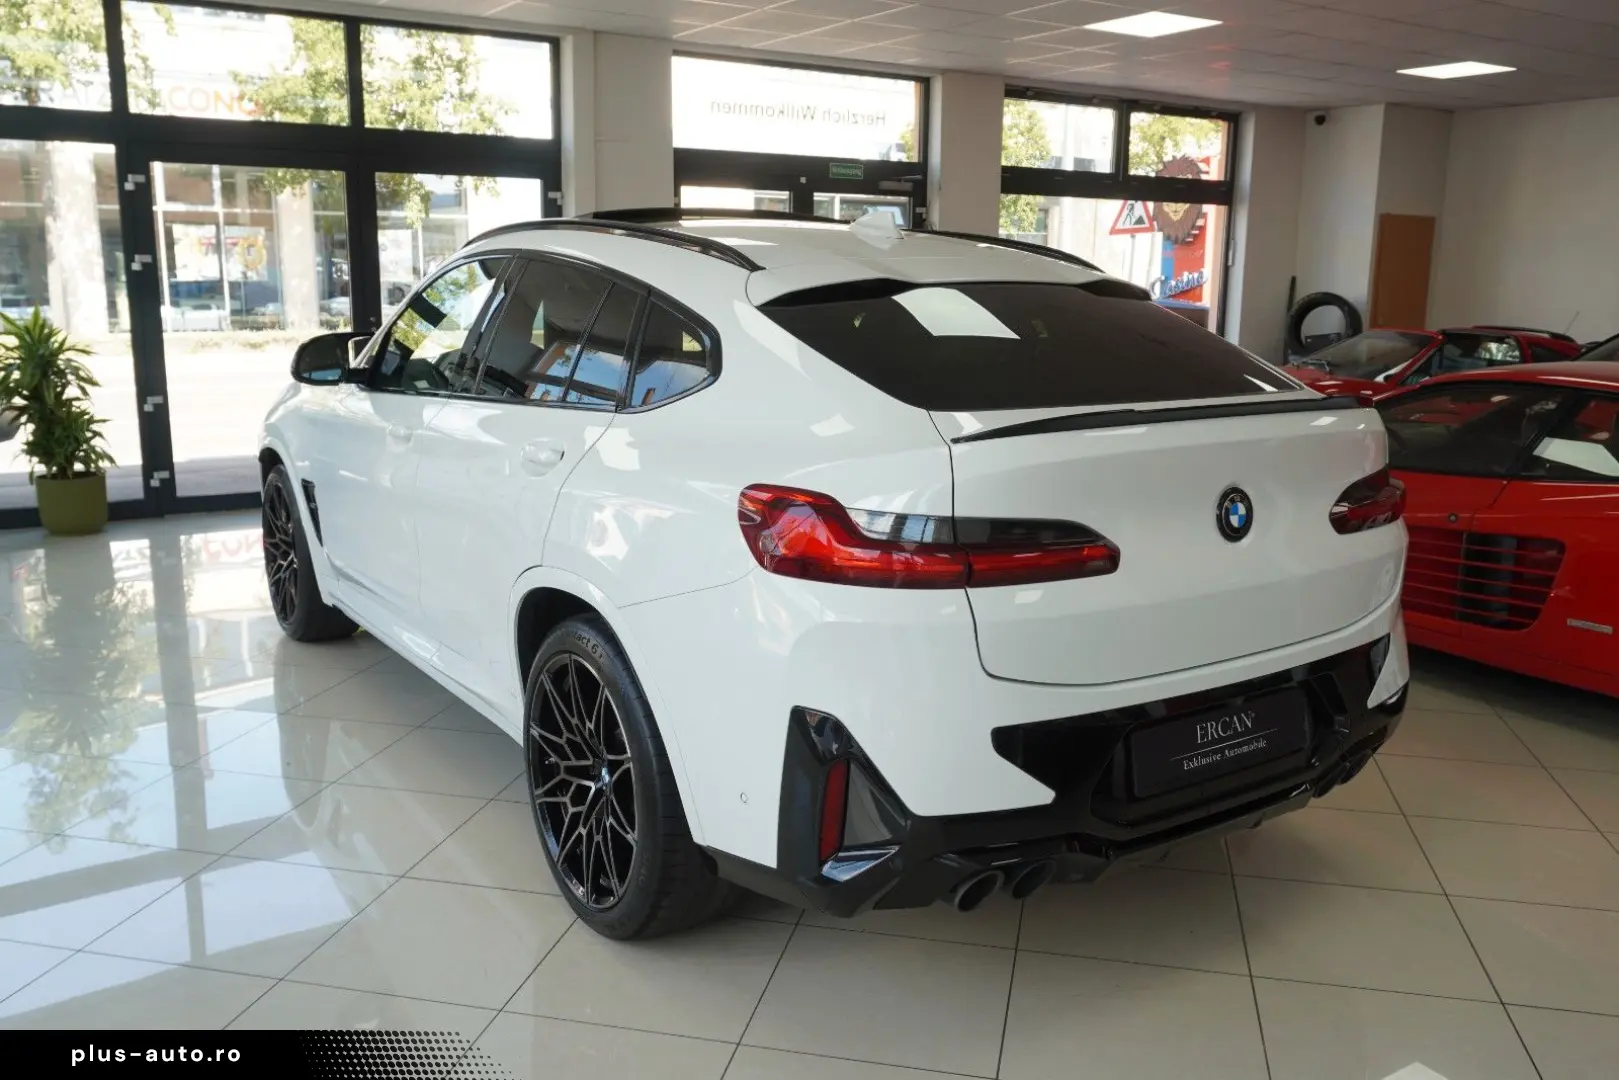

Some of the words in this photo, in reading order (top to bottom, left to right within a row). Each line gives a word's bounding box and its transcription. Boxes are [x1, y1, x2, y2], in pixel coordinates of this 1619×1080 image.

[1149, 269, 1208, 299] Casino
[1196, 710, 1253, 744] ERCAN
[1183, 752, 1222, 770] Exklusive
[1223, 737, 1267, 759] Automobile
